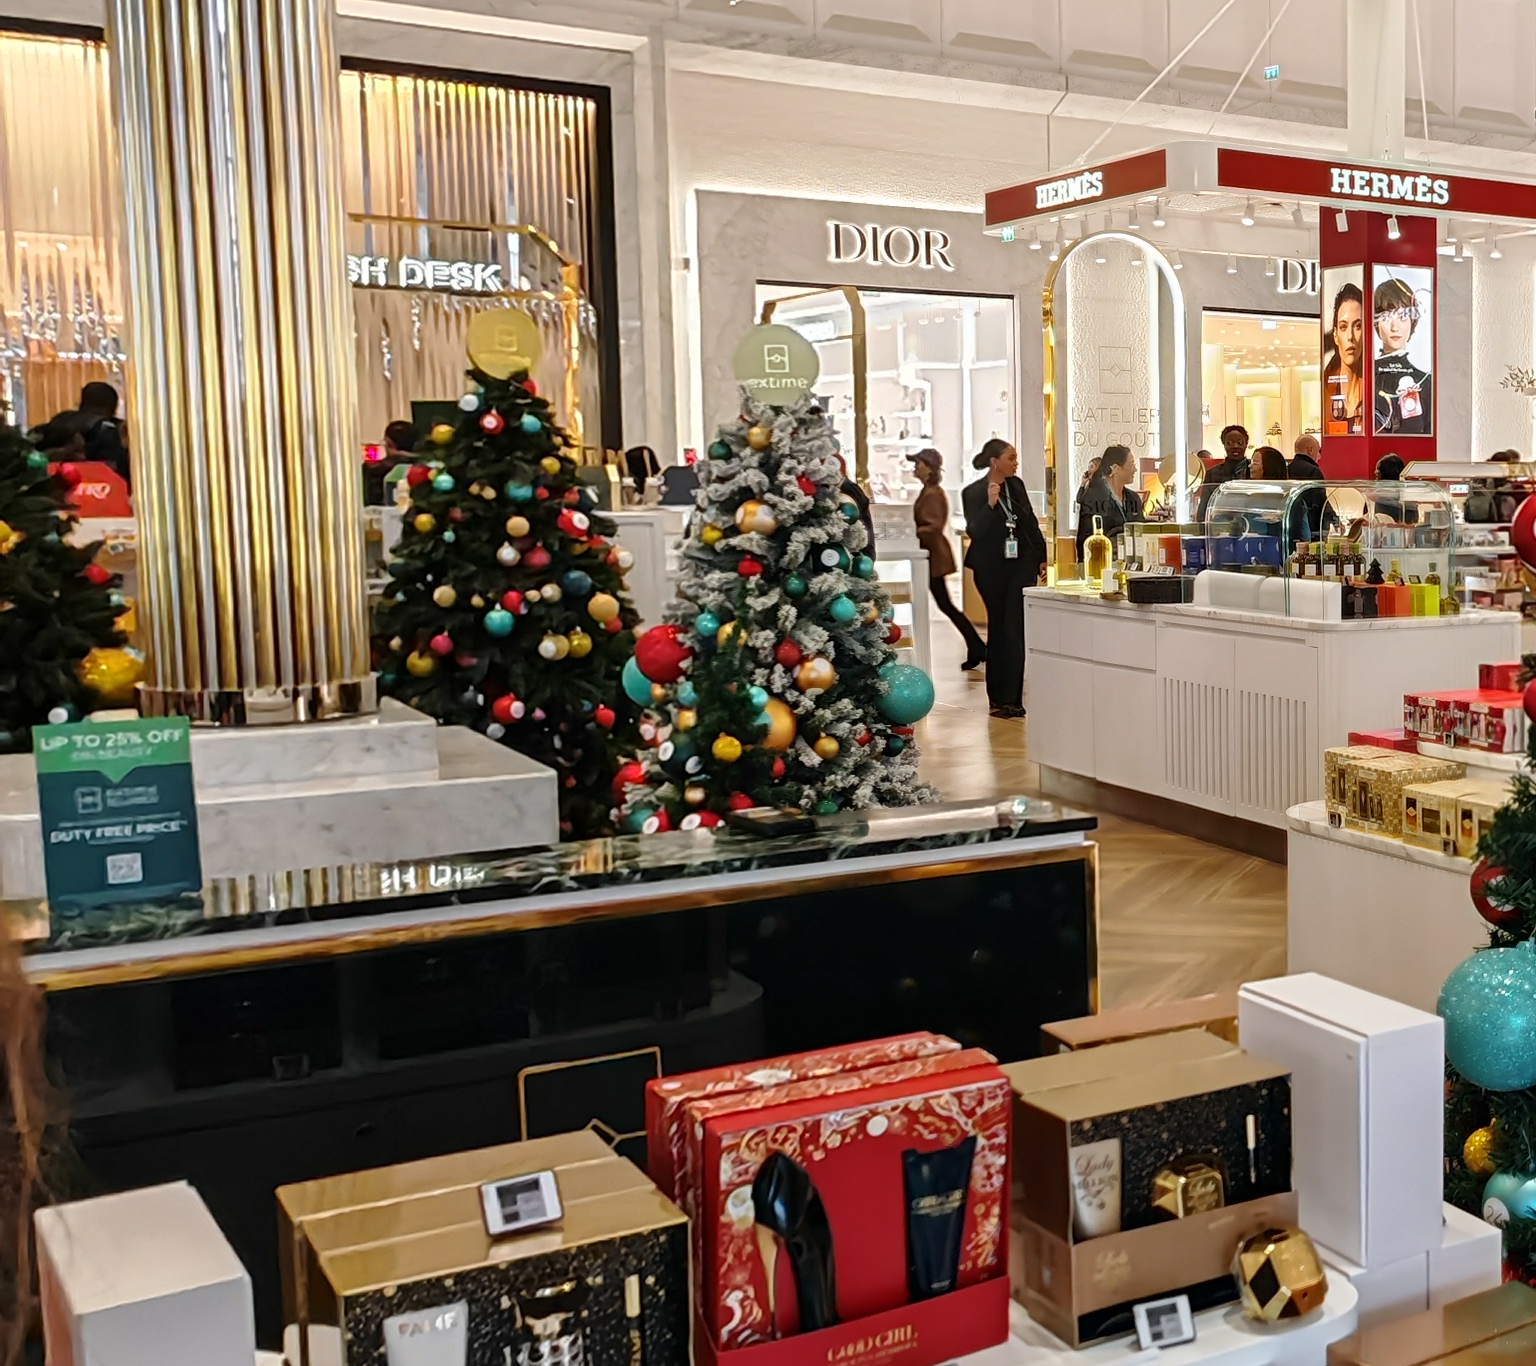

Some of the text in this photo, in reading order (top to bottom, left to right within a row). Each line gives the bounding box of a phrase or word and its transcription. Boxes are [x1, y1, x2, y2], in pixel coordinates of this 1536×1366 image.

[1035, 171, 1103, 209] HERMÈS
[1330, 167, 1450, 206] HERMÈS
[827, 220, 955, 271] DIOR
[346, 255, 502, 292] SH DESK
[1277, 257, 1320, 294] DI
[748, 375, 808, 389] extime
[1074, 432, 1099, 447] DU
